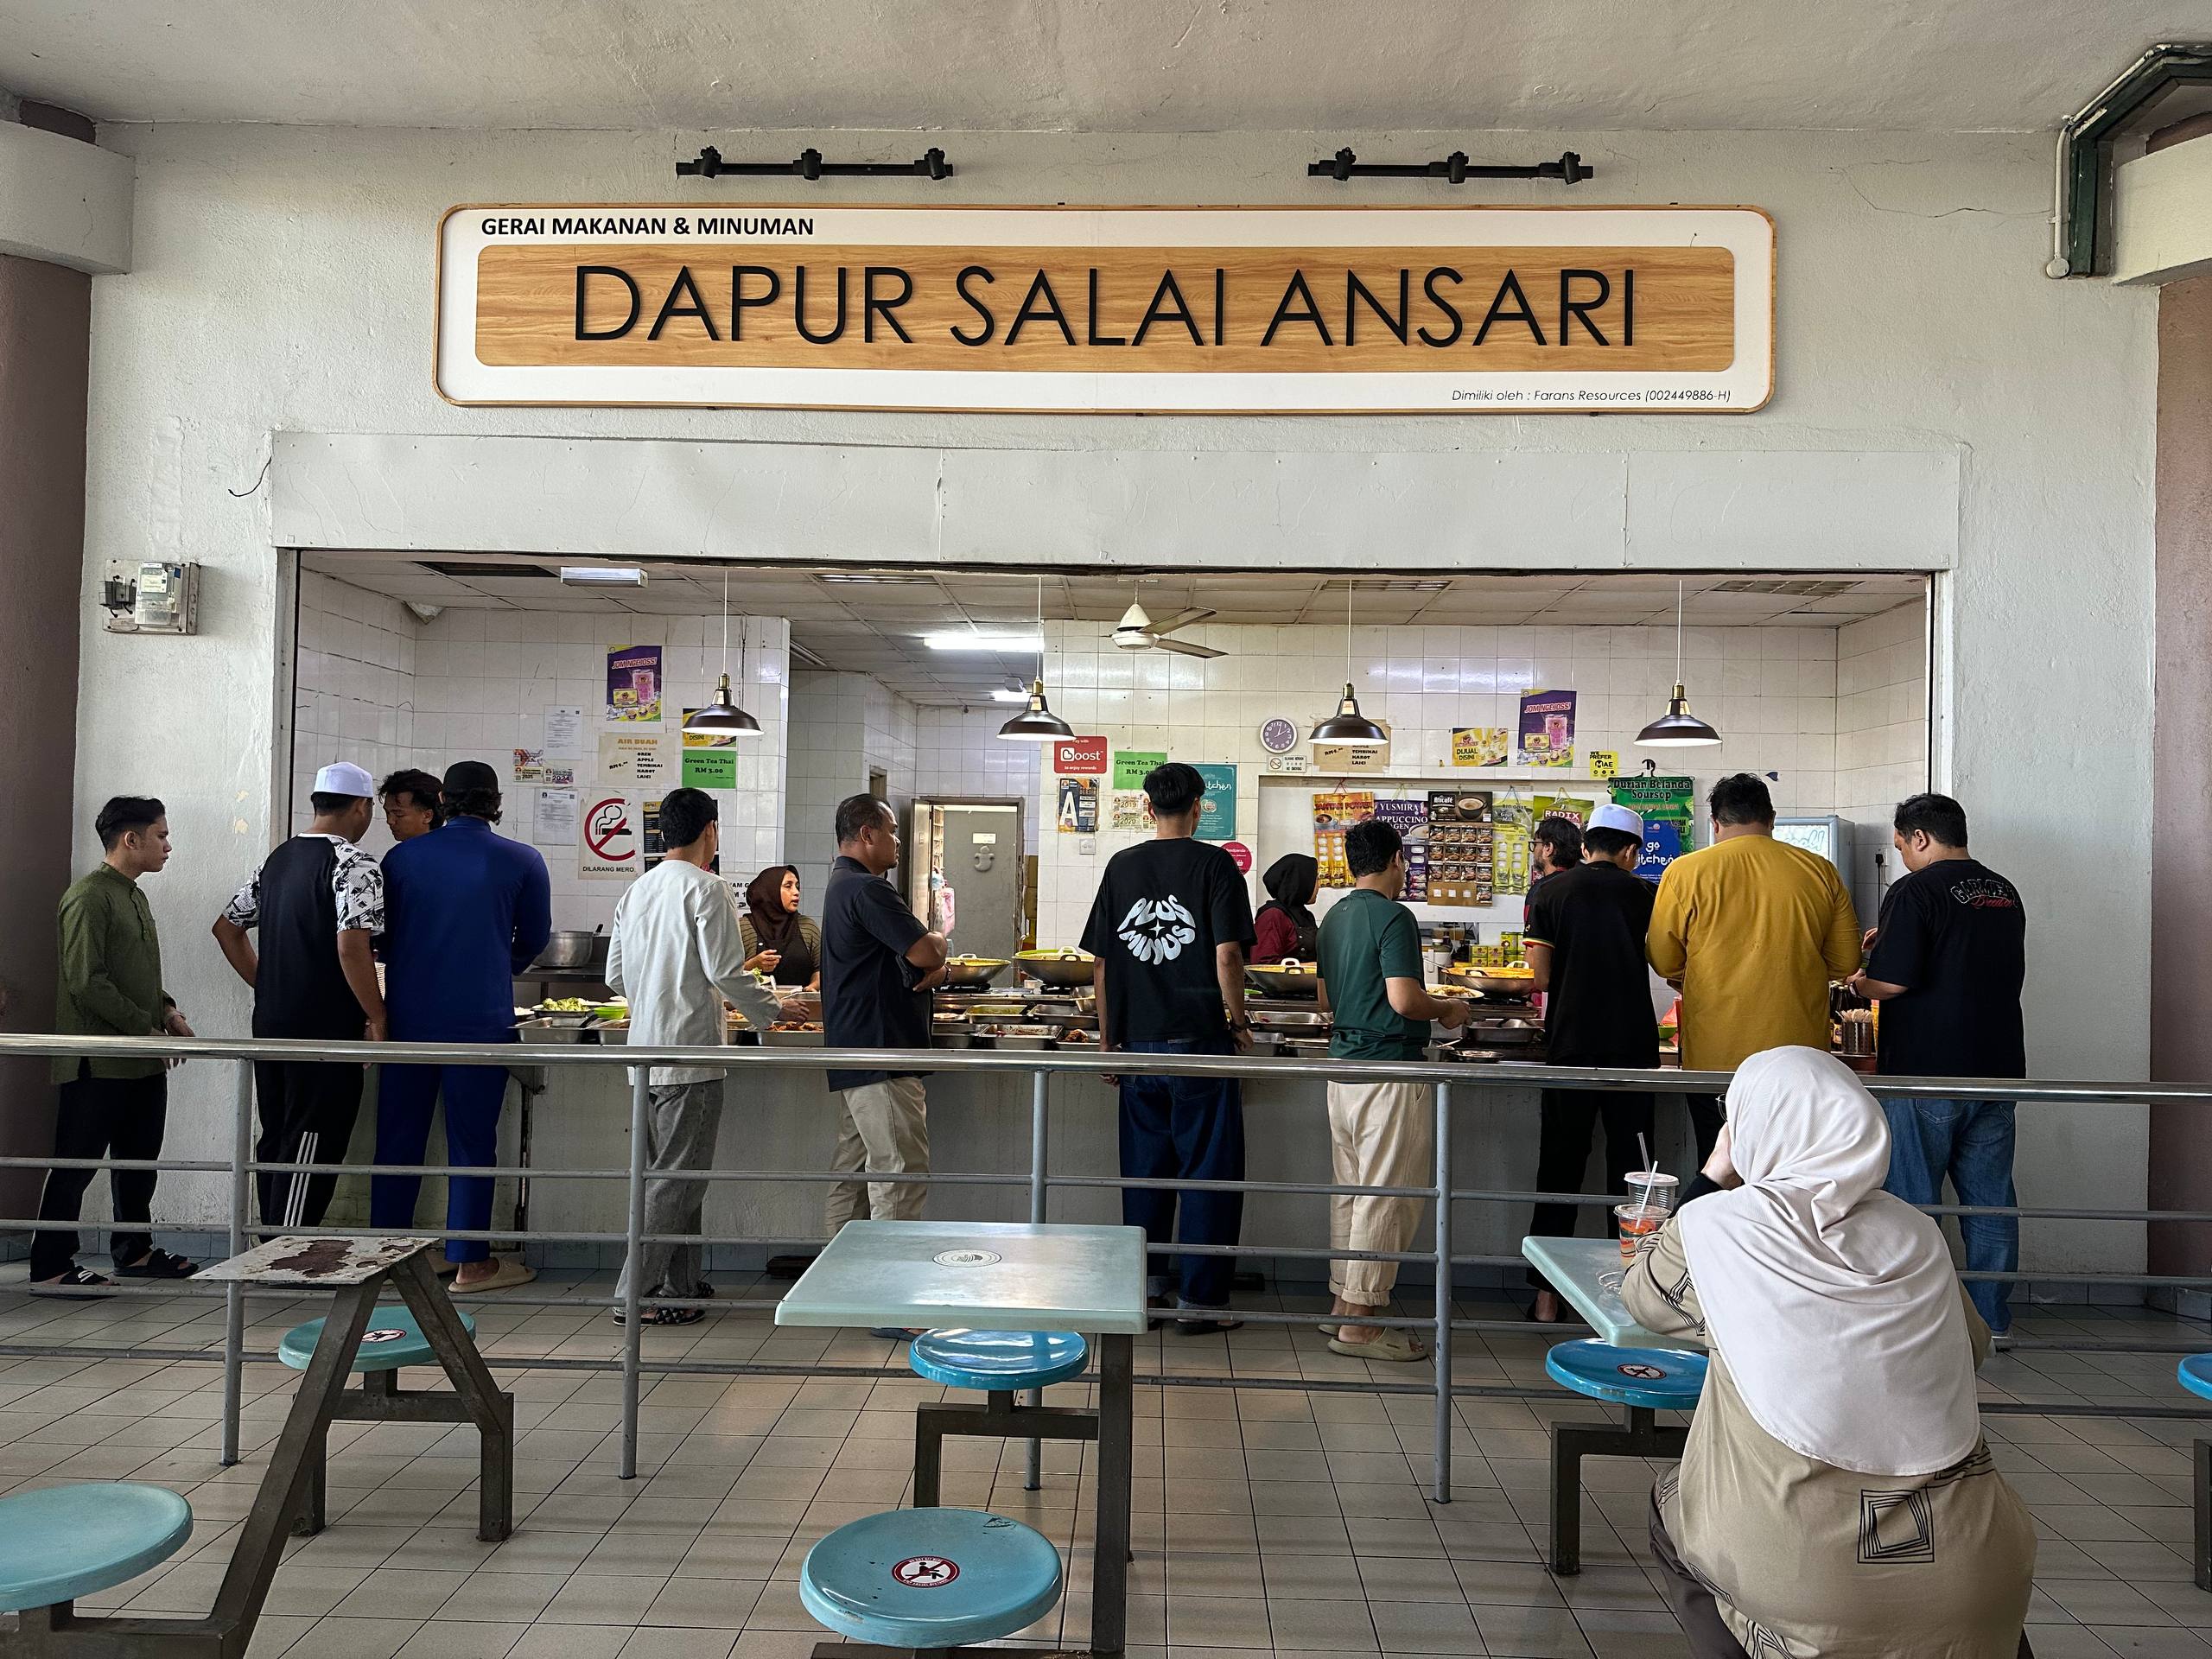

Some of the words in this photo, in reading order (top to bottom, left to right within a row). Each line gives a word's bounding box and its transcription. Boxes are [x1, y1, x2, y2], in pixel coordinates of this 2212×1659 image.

[481, 218, 544, 235] GERAI
[552, 218, 666, 235] MAKANAN
[673, 217, 690, 235] &
[698, 218, 814, 236] MINUMAN
[575, 264, 913, 346] DAPUR
[950, 265, 1224, 347] SALAI
[1260, 266, 1634, 348] ANSARI
[1452, 390, 1493, 401] Dimiliki
[1497, 390, 1523, 401] oleh
[1534, 391, 1575, 401] Farans
[1578, 391, 1641, 401] Resources
[1645, 390, 1731, 403] (002449886-H)
[1524, 704, 1541, 714] JOM
[1613, 779, 1647, 789] Durian
[1649, 779, 1691, 789] Belanda
[1632, 789, 1672, 801] Soursop
[1059, 791, 1078, 827] A
[1380, 803, 1419, 811] YUSMIRA
[1545, 810, 1580, 820] RADIX
[1637, 854, 1675, 866] itchen
[1116, 893, 1197, 932] PLUS
[1118, 925, 1197, 965] MINUS
